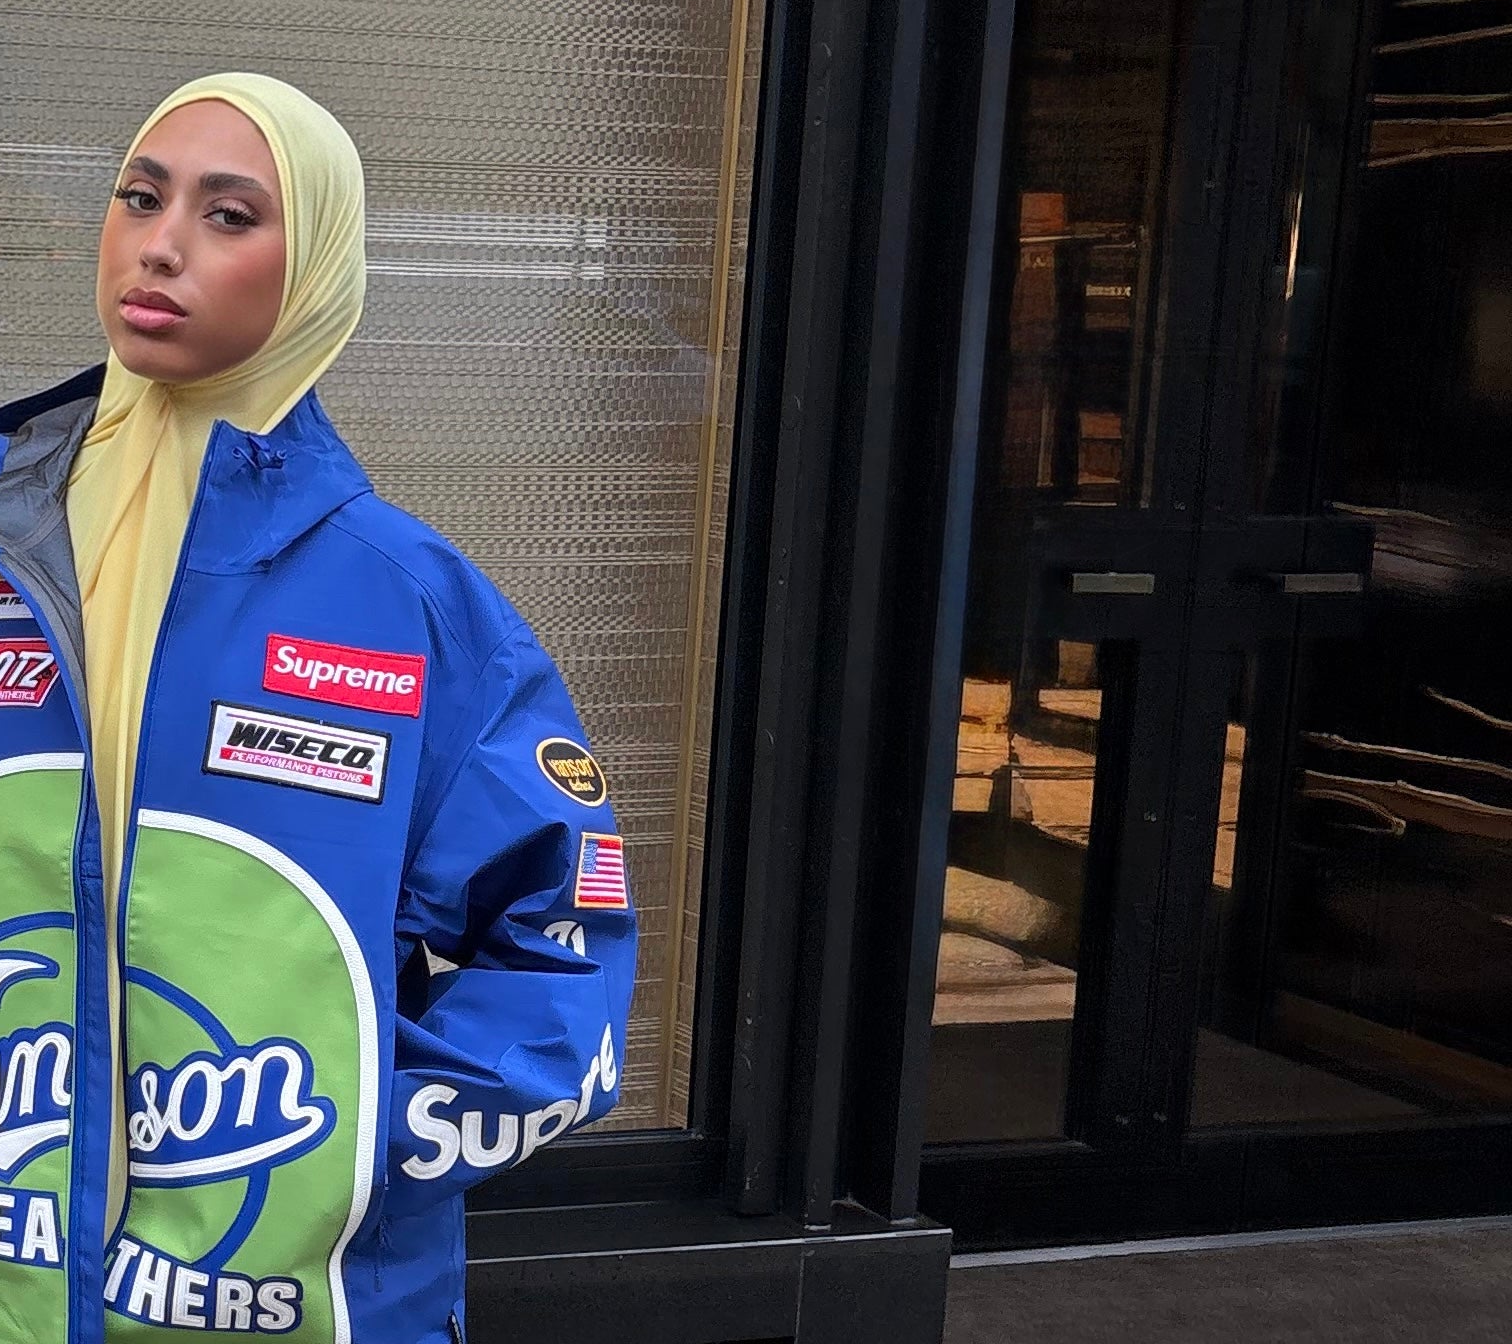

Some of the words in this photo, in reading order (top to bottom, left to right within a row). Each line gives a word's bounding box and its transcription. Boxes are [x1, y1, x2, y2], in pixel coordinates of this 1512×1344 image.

[273, 646, 416, 694] Supreme
[226, 721, 376, 769] WISECO
[229, 751, 315, 774] PERFORMANCE
[315, 767, 365, 784] PISTONS
